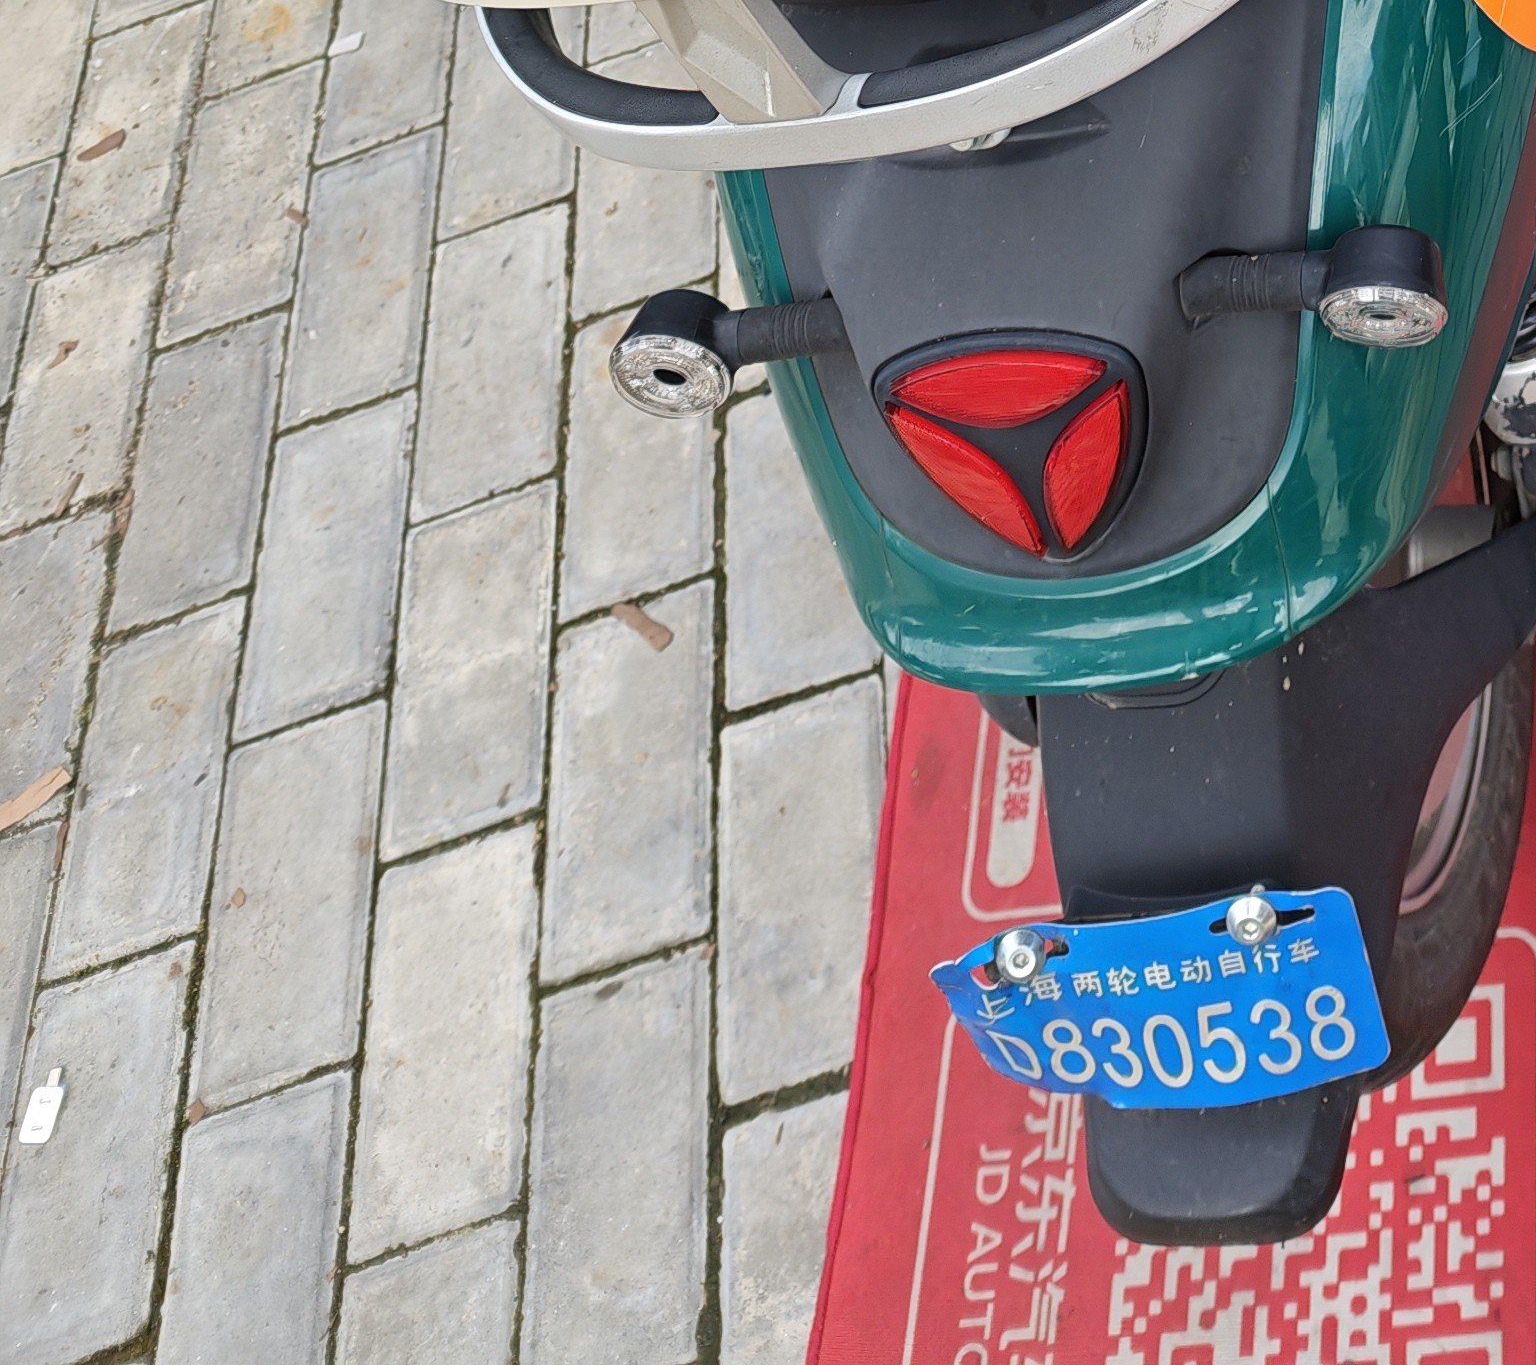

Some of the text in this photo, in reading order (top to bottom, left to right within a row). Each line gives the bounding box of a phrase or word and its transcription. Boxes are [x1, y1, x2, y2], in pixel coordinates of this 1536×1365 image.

[1072, 937, 1321, 1000] 两轮电动自行车
[975, 1142, 1012, 1205] JD
[998, 1083, 1084, 1365] 京东汽
